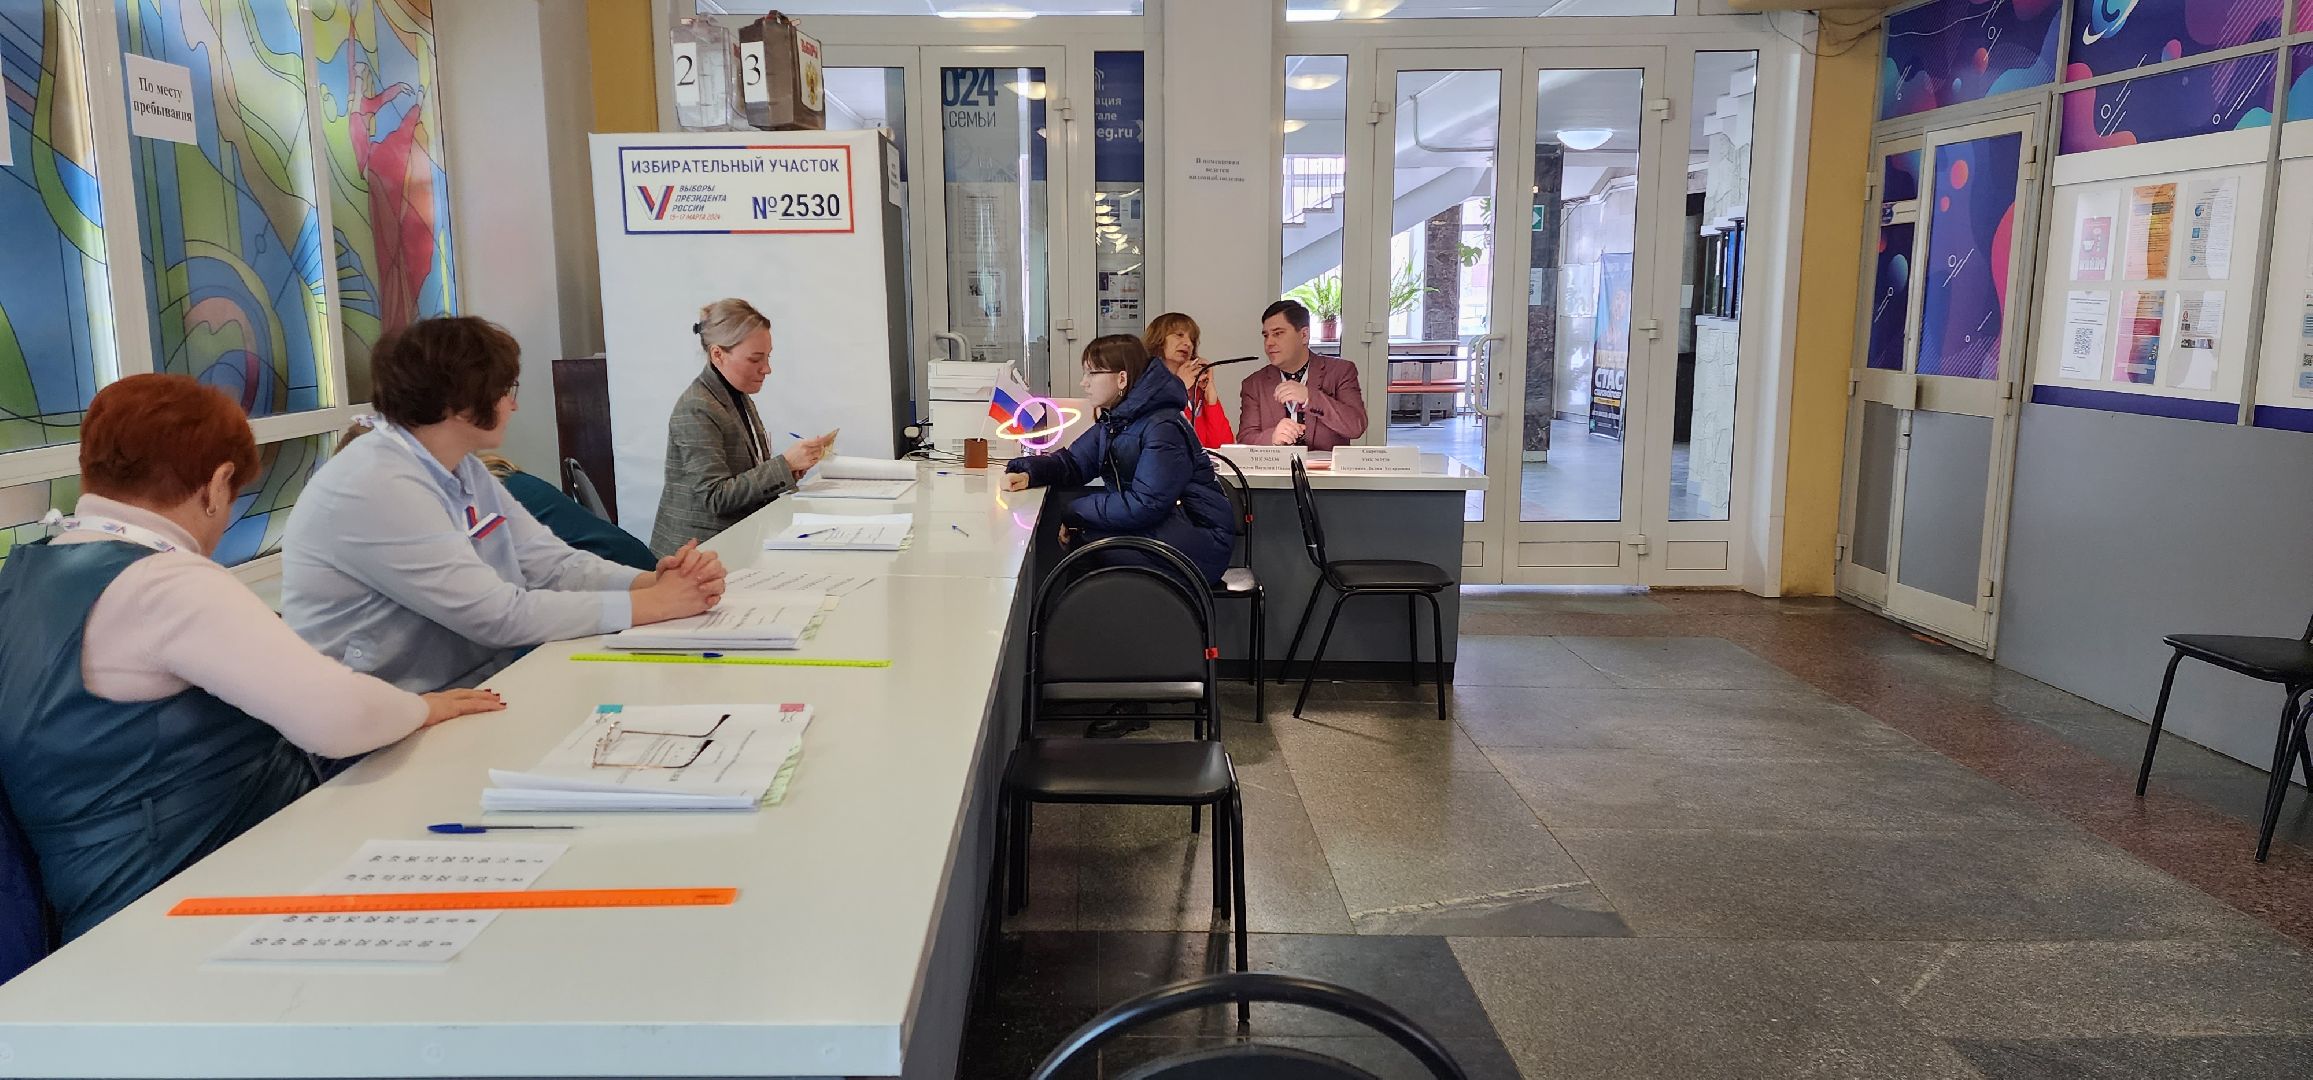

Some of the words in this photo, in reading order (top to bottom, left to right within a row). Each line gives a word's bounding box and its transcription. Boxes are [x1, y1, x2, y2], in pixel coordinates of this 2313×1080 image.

[676, 54, 696, 87] 2
[744, 53, 761, 86] 3
[138, 76, 154, 93] По
[156, 84, 183, 103] месту
[133, 100, 193, 123] пребывания
[631, 156, 765, 174] ИЗБИРАТЕЛЬНЫЙ
[769, 158, 840, 173] УЧАСТОК
[675, 194, 727, 203] ПРЕЗИДЕНТА
[679, 184, 716, 192] ВЫБОРЫ
[671, 204, 705, 212] РОССИИ
[1594, 367, 1625, 390] СТАС
